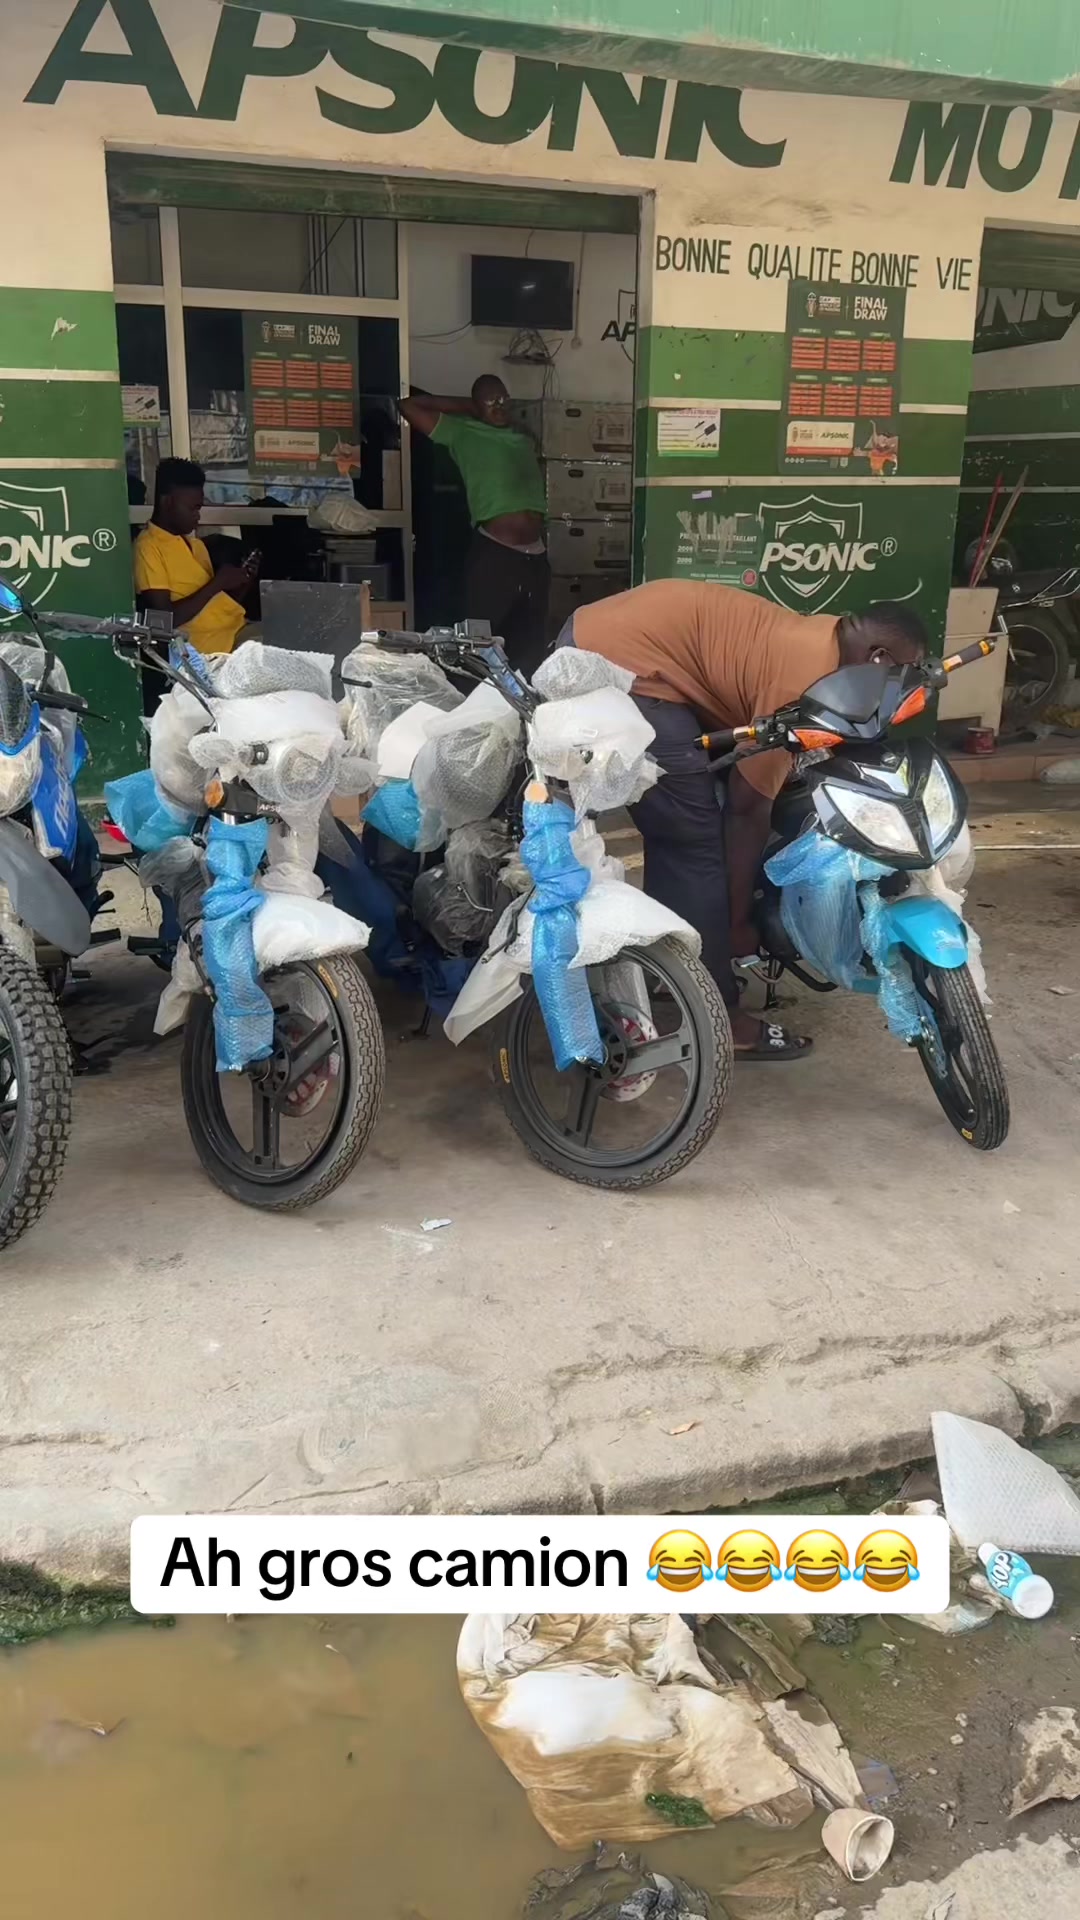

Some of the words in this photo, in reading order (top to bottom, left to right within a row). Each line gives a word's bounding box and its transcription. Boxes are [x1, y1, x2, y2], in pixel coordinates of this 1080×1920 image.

[23, 0, 787, 168] APSONIC
[655, 235, 732, 275] BONNE
[747, 243, 842, 281] QUALITE
[851, 250, 919, 288] BONNE
[936, 256, 973, 291] VIE
[854, 296, 888, 309] FINAL
[975, 287, 1075, 327] NIC
[854, 307, 888, 320] DRAW
[308, 324, 340, 336] FINAL
[308, 334, 340, 346] DRAW
[820, 431, 849, 439] APSONIC
[991, 1552, 1012, 1589] YOP
